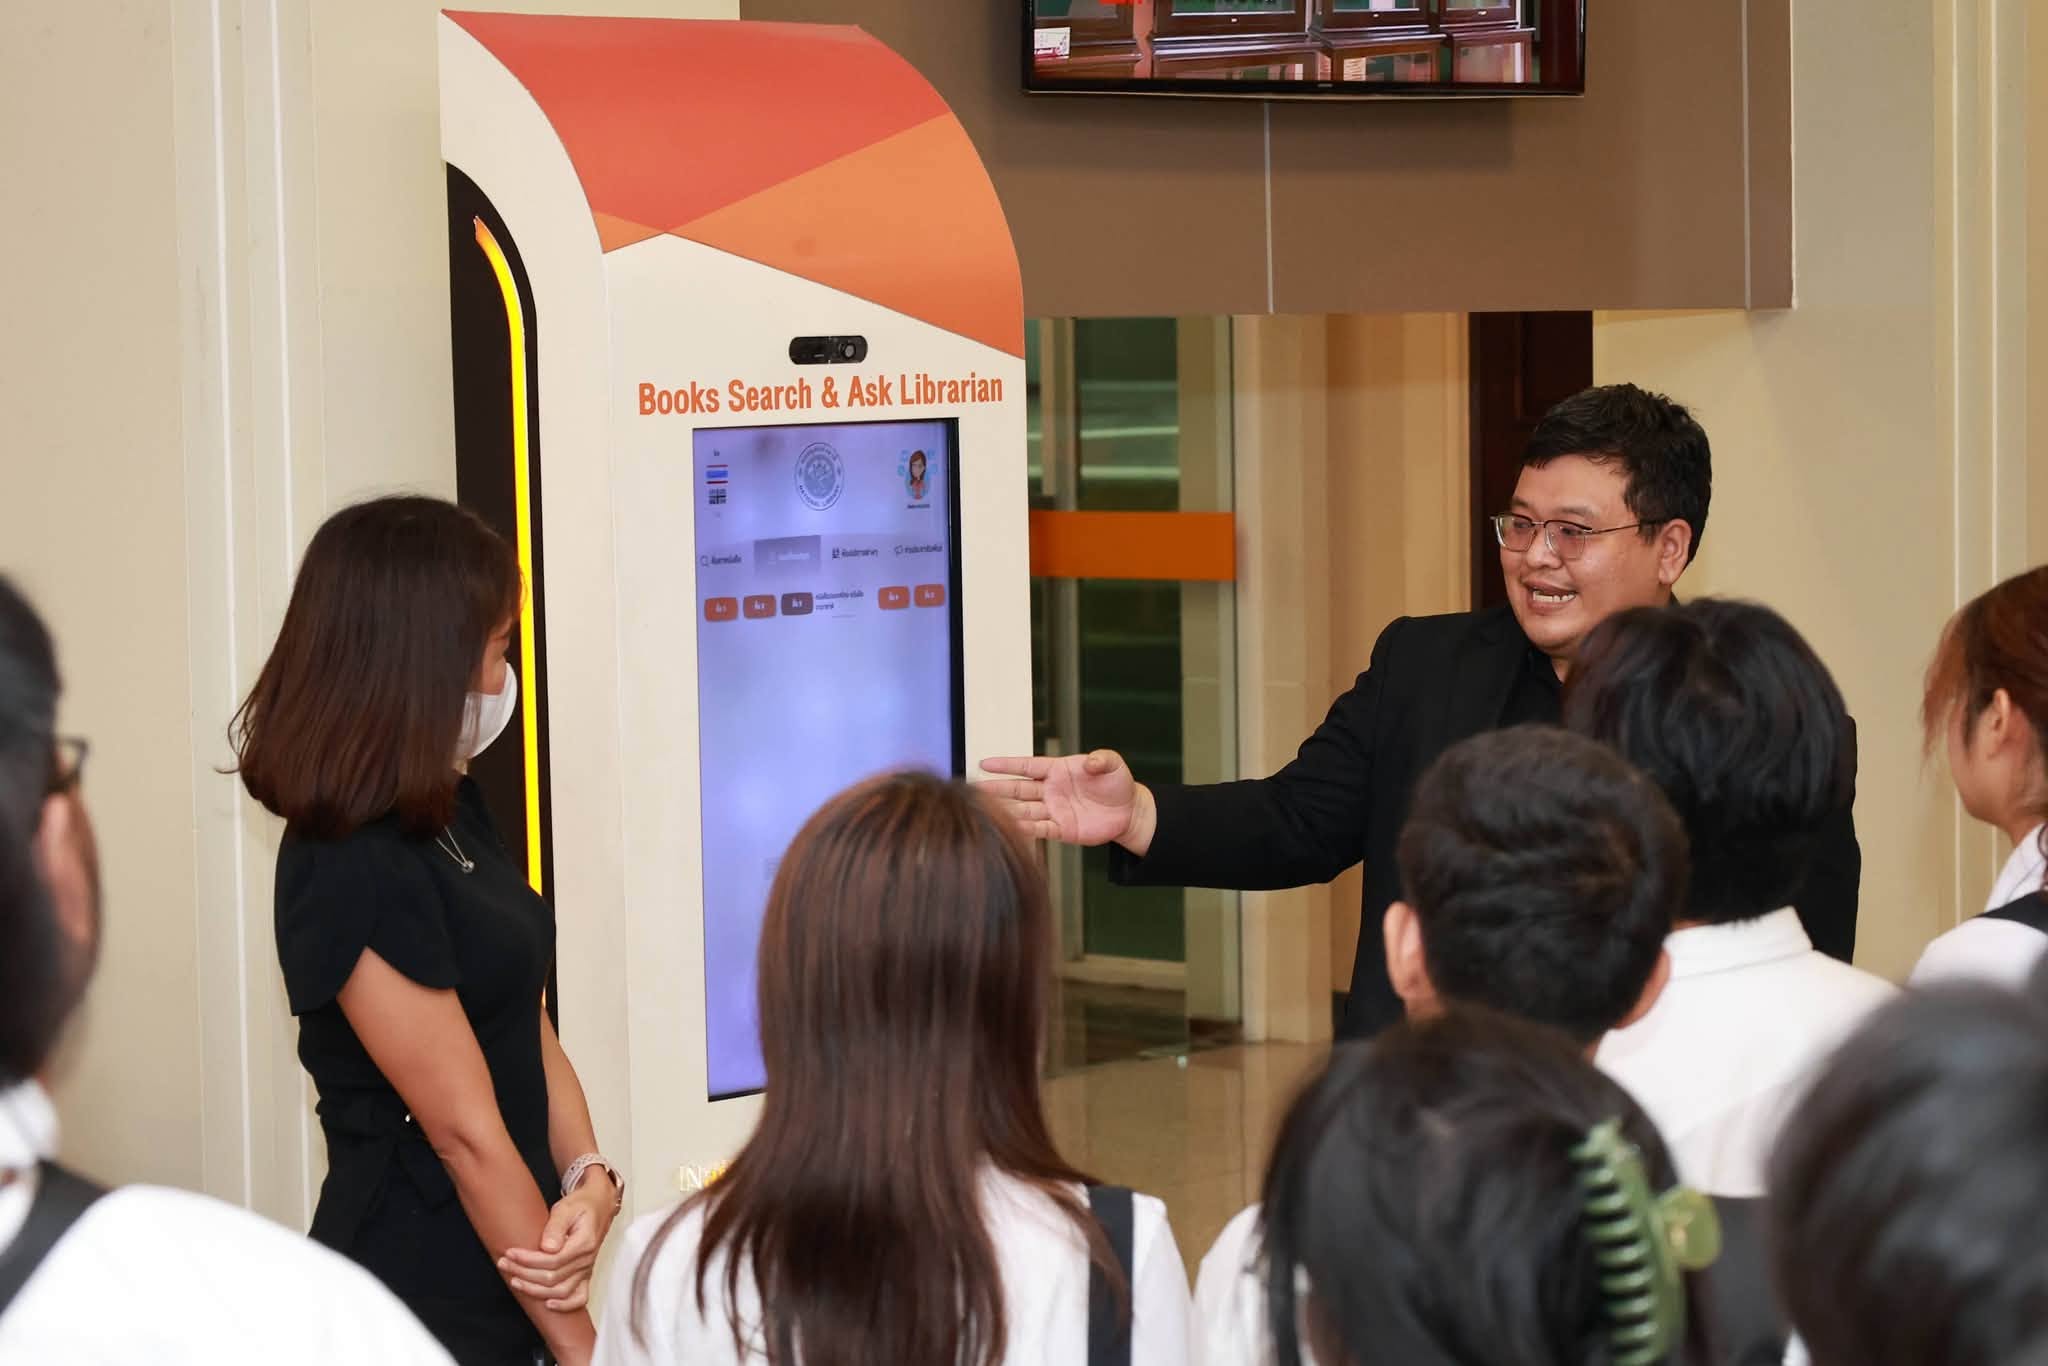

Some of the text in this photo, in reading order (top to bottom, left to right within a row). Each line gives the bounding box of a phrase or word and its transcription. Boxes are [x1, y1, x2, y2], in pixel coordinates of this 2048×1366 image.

[638, 372, 1003, 415] Books Search & Ask Librarian
